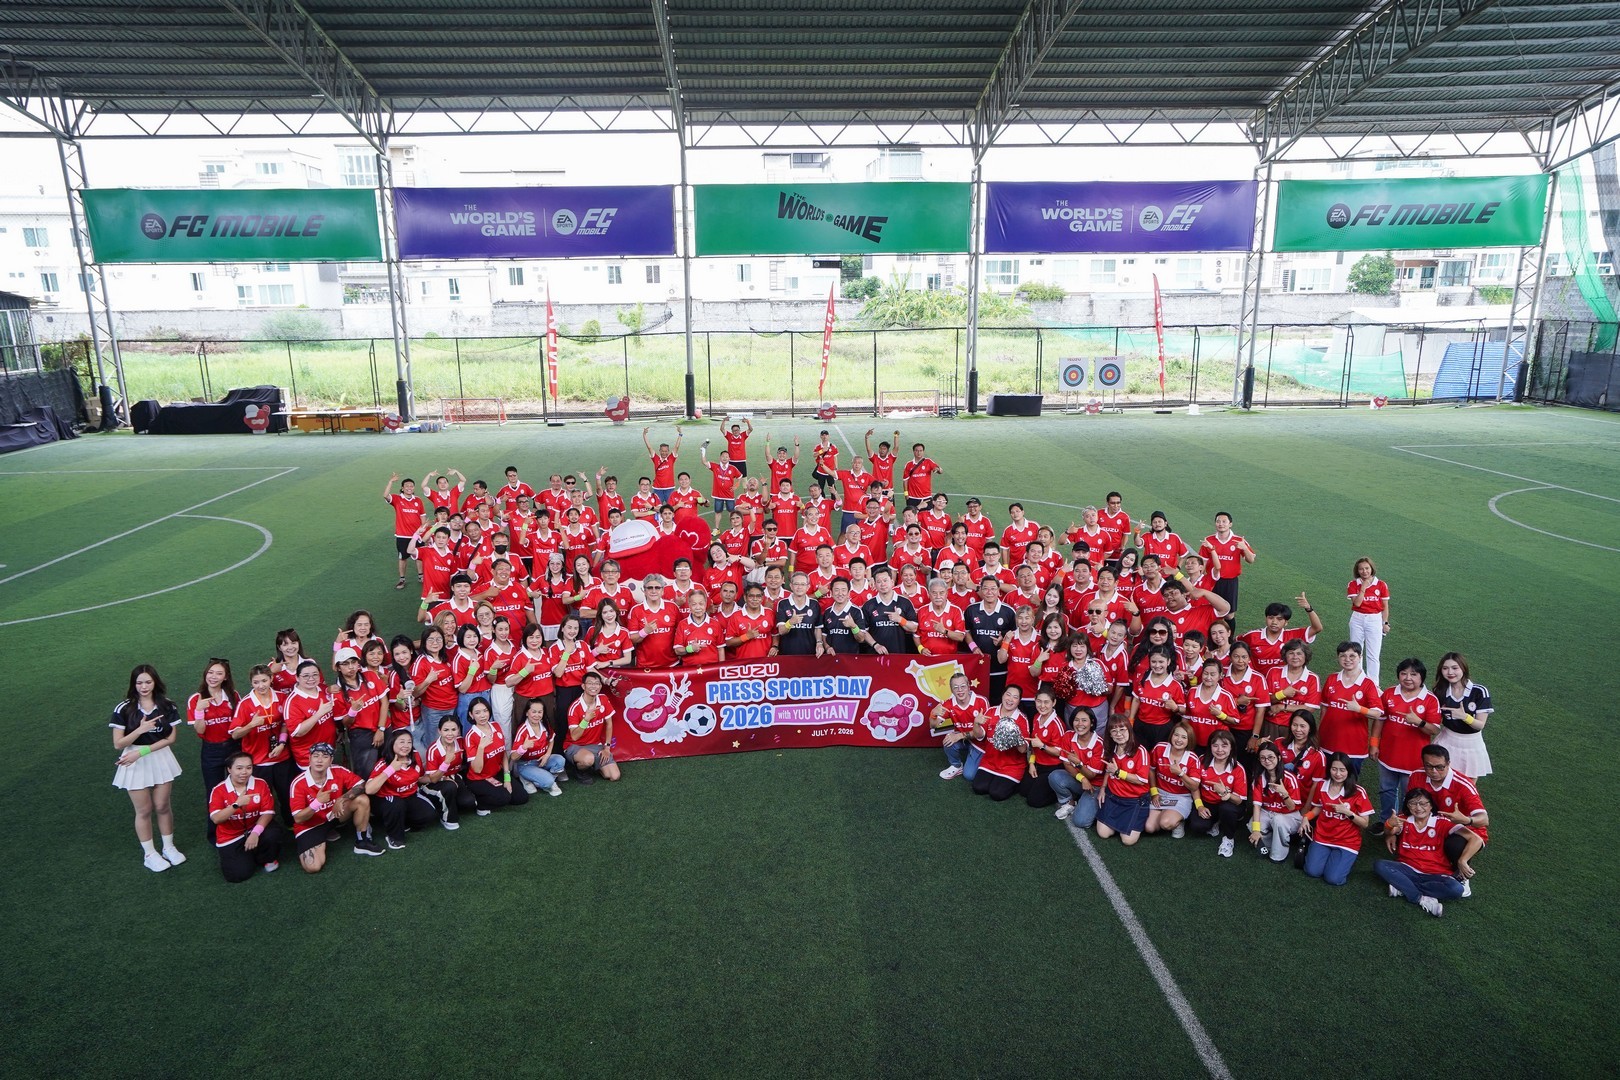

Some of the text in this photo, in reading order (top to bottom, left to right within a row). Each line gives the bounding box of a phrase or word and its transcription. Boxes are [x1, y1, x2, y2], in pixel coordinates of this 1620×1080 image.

[793, 192, 805, 200] THE
[450, 211, 535, 225] WORLD'S
[557, 214, 572, 223] EA
[580, 208, 618, 228] FC
[778, 191, 888, 243] WORLD'S GAME
[1041, 208, 1123, 220] WORLD'S
[1144, 211, 1159, 220] EA
[1165, 205, 1203, 224] FC
[1331, 209, 1346, 218] EA
[1350, 202, 1501, 226] FC MOBILE
[145, 218, 161, 228] EA
[169, 215, 325, 237] FC MOBILE
[1069, 220, 1122, 232] GAME
[481, 224, 537, 236] GAME
[533, 671, 553, 681] ISUZ
[720, 664, 779, 679] ISUZU
[708, 678, 870, 702] PRESS SPORTS DAY
[318, 711, 333, 725] ISUZ
[722, 705, 848, 728] 2026 with YUU CHAN
[811, 729, 828, 737] JULY
[529, 746, 548, 756] ISUZ
[228, 812, 259, 820] SUZU
